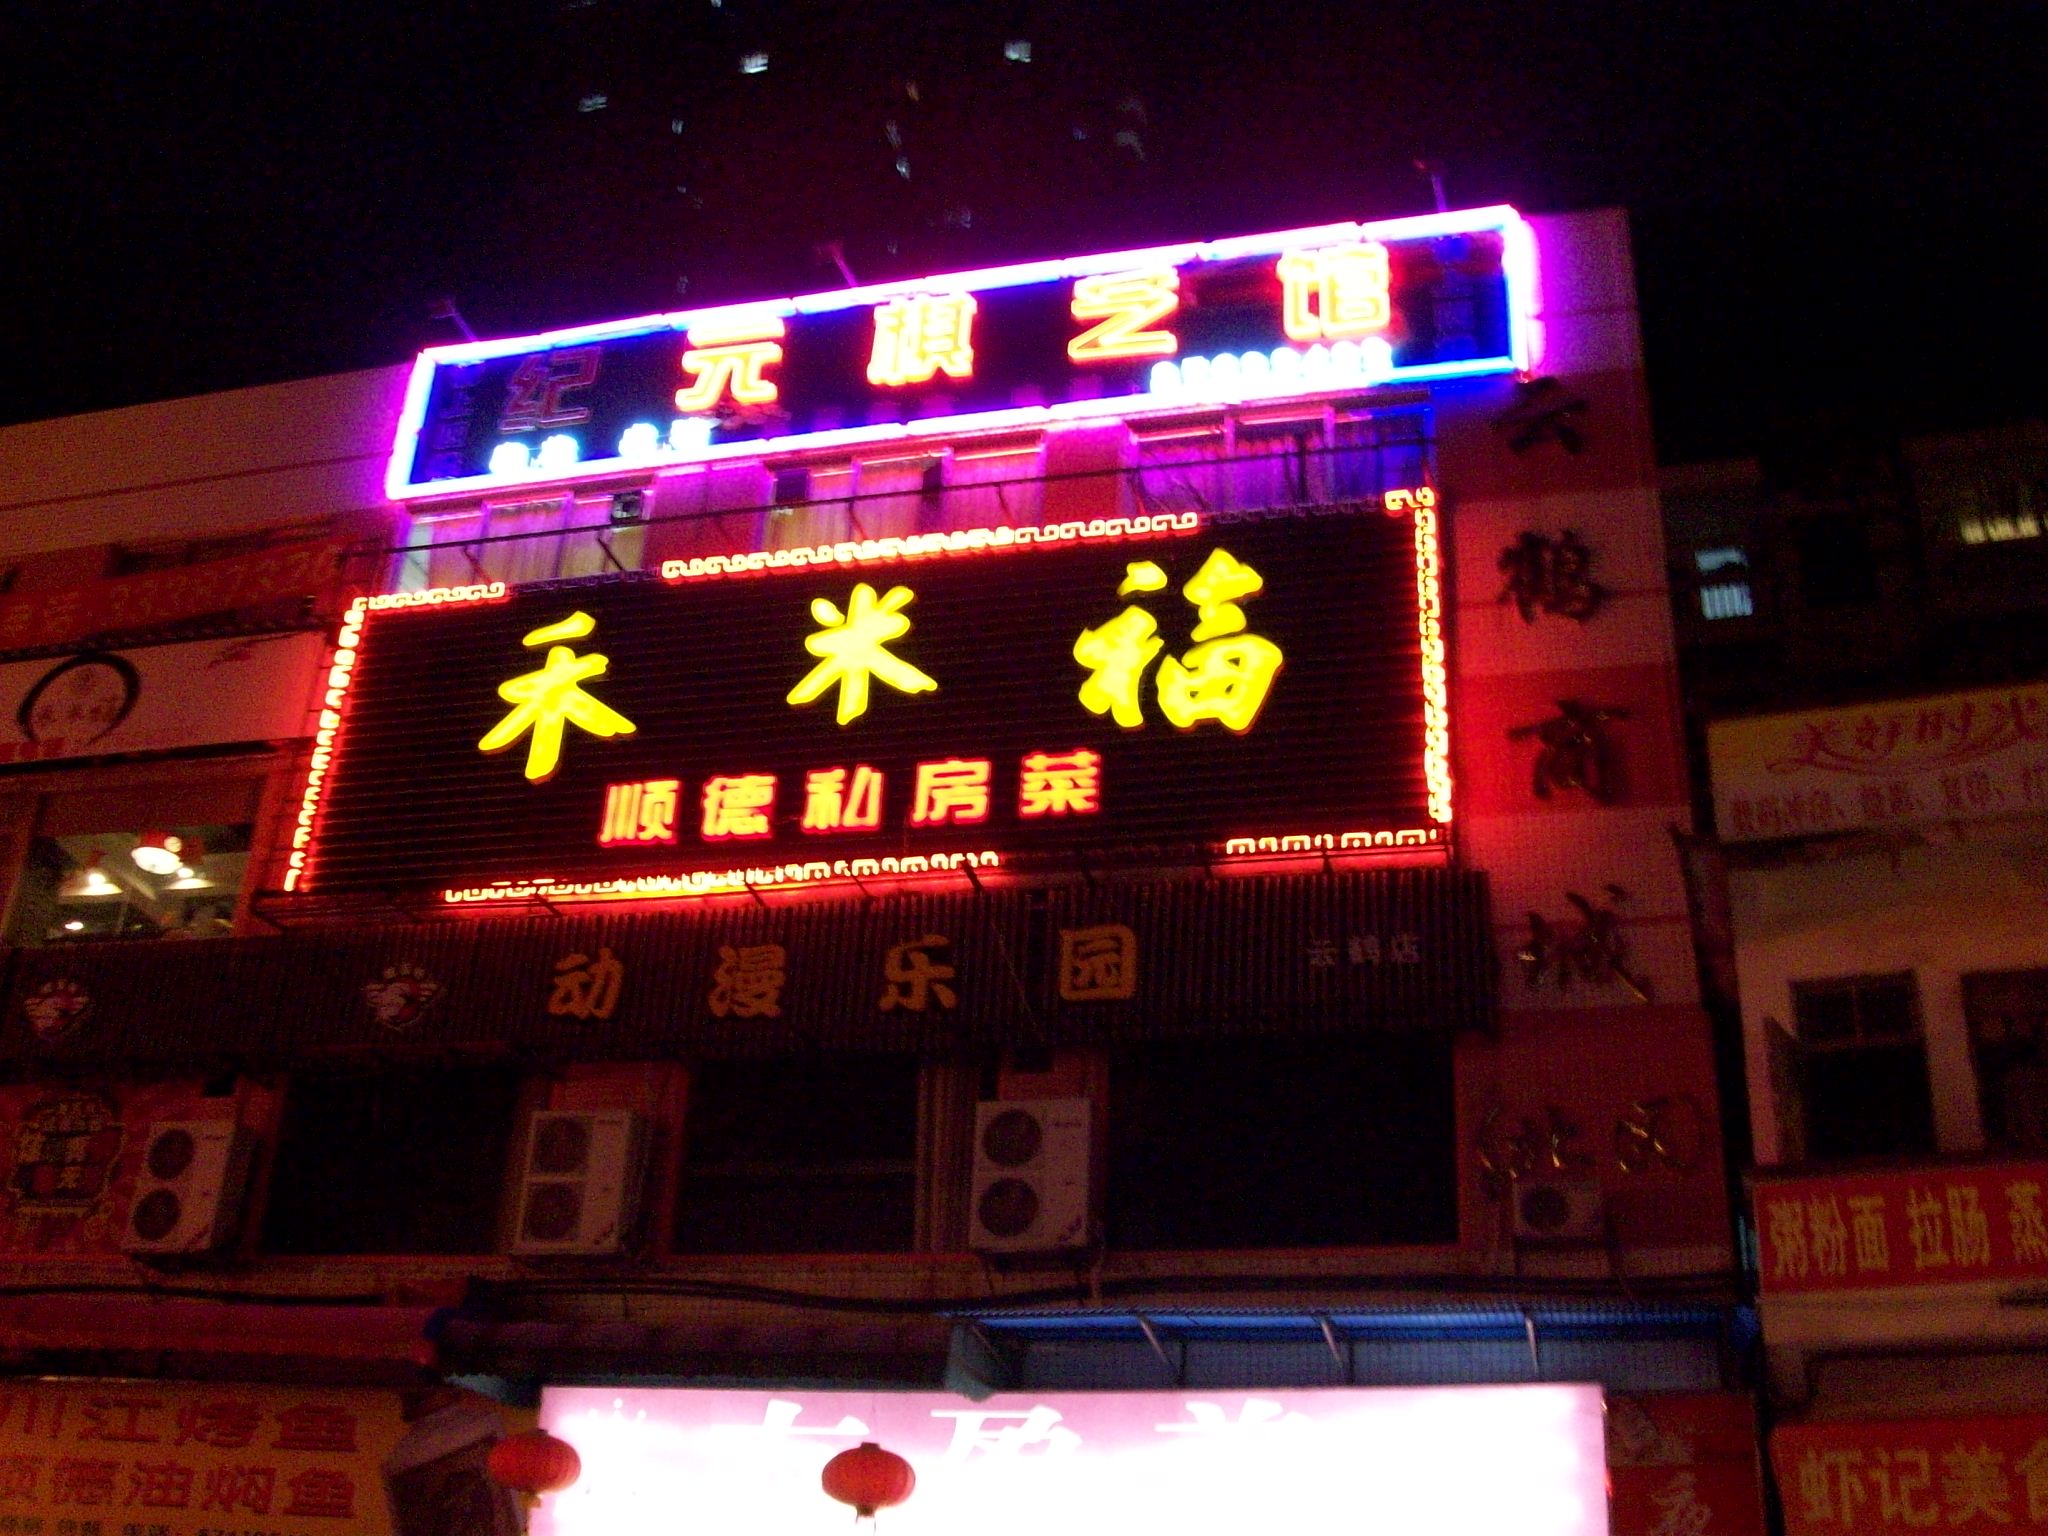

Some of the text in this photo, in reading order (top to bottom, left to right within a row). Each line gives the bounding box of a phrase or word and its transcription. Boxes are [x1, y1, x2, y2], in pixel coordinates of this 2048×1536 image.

[477, 547, 1285, 783] 禾米福
[598, 748, 1104, 848] 顺德私房菜
[546, 924, 1140, 1020] 动漫乐园
